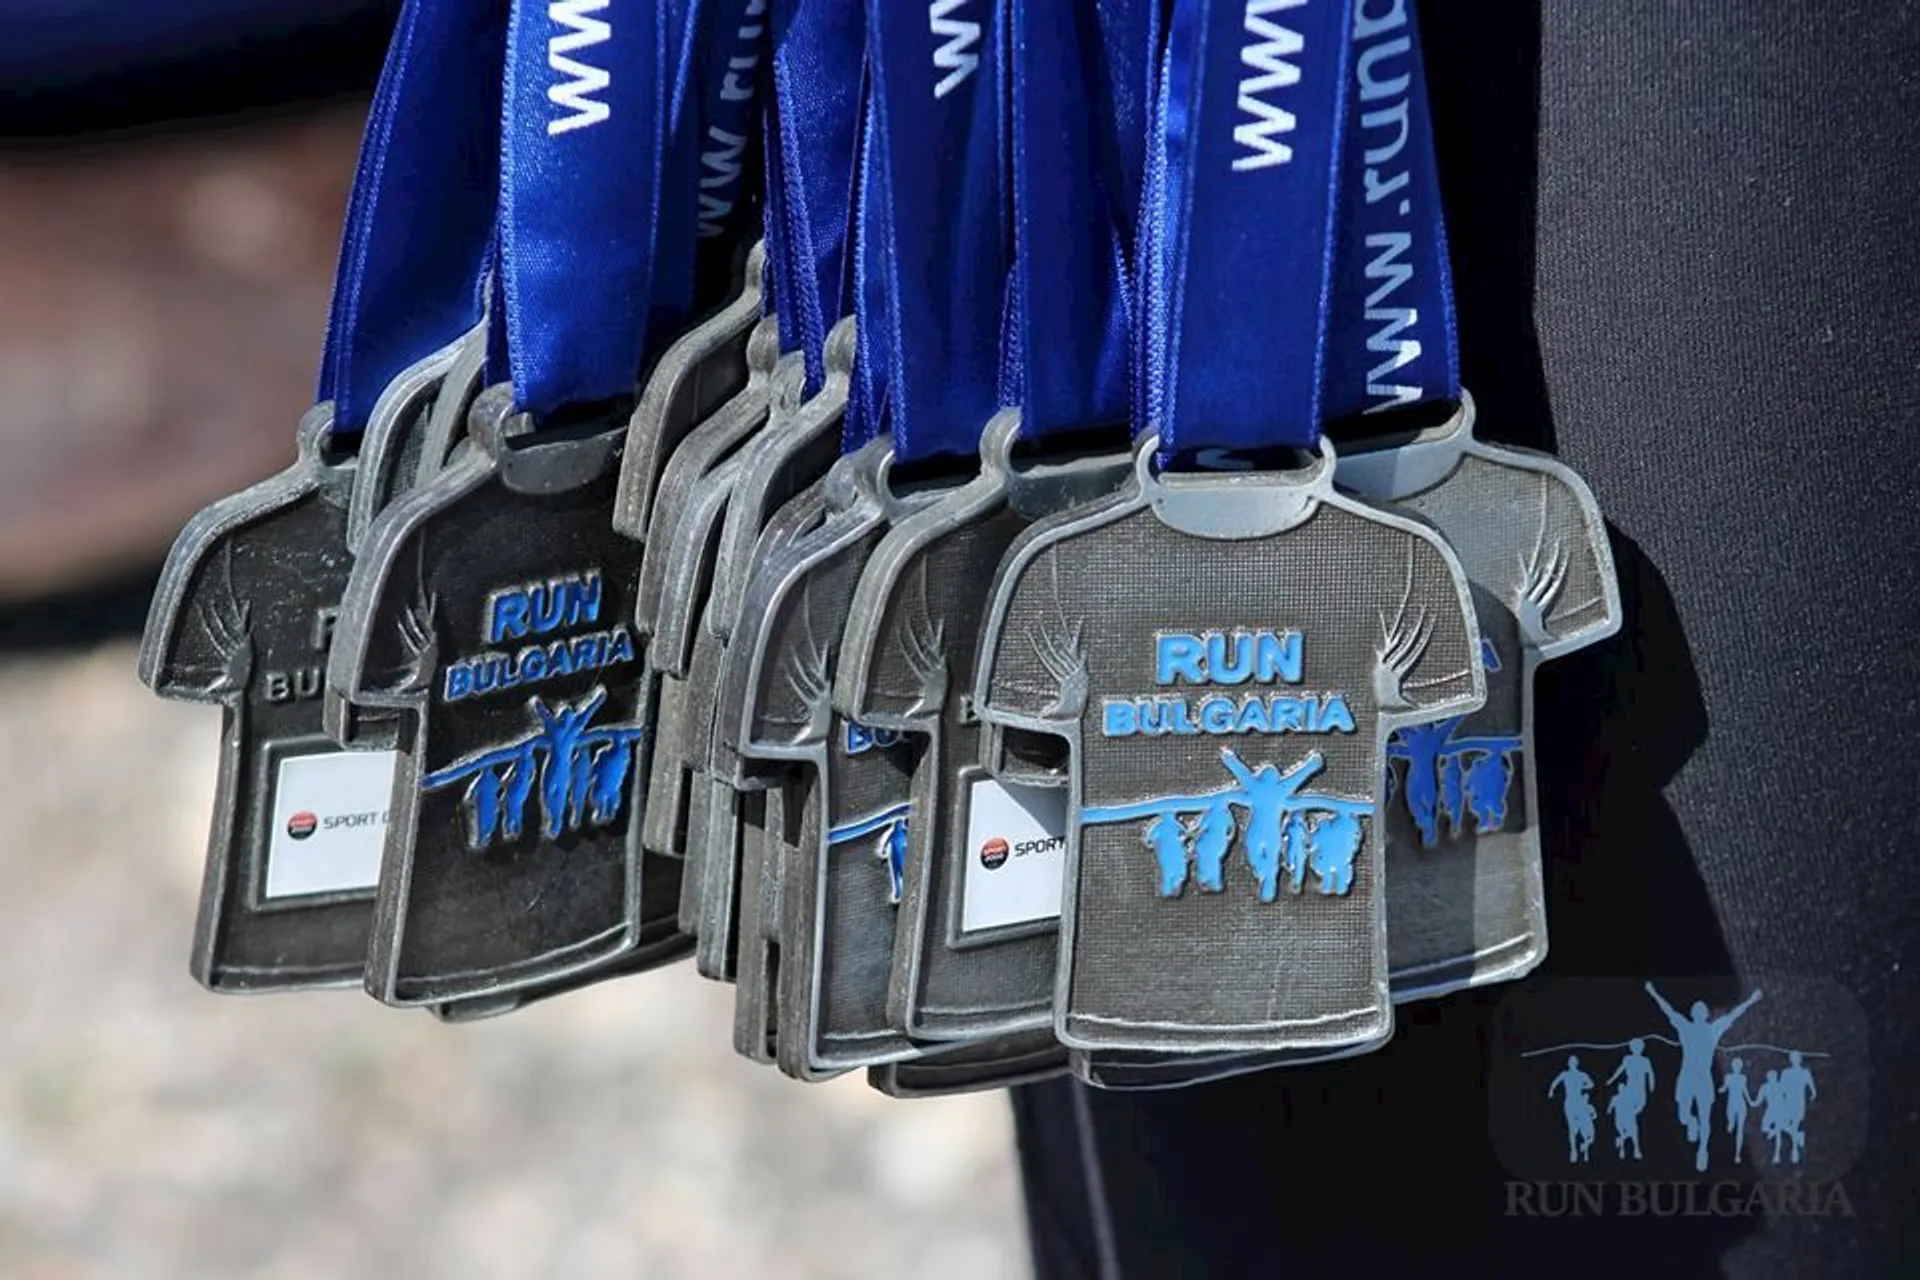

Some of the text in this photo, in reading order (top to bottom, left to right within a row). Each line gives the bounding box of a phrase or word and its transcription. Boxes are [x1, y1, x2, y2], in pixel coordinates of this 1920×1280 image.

[1231, 0, 1307, 172] ww
[487, 566, 602, 643] RUN
[443, 624, 635, 702] BULGARIA
[1155, 628, 1305, 686] RUN
[1102, 694, 1356, 738] BULGARIA
[323, 812, 376, 830] SPORT
[1014, 835, 1066, 857] SPORT
